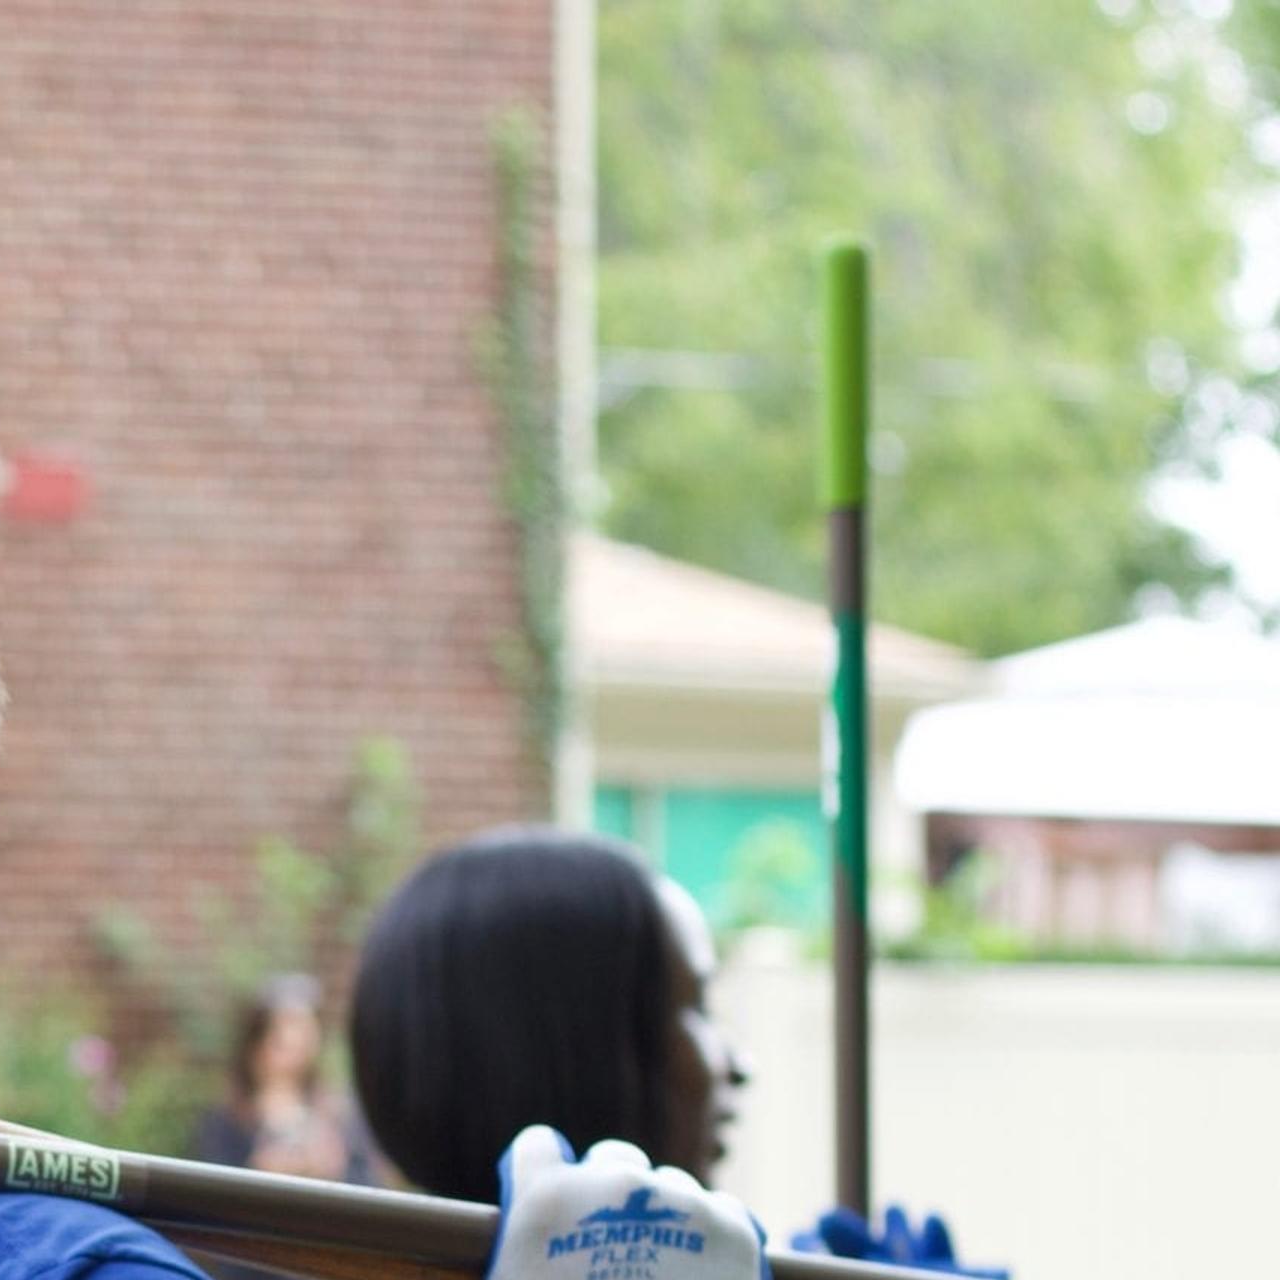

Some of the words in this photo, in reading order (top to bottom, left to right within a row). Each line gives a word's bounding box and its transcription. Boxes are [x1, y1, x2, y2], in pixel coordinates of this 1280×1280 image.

[18, 1148, 109, 1188] AMES
[547, 1225, 704, 1259] MEMPHIS
[591, 1249, 658, 1266] FLEX
